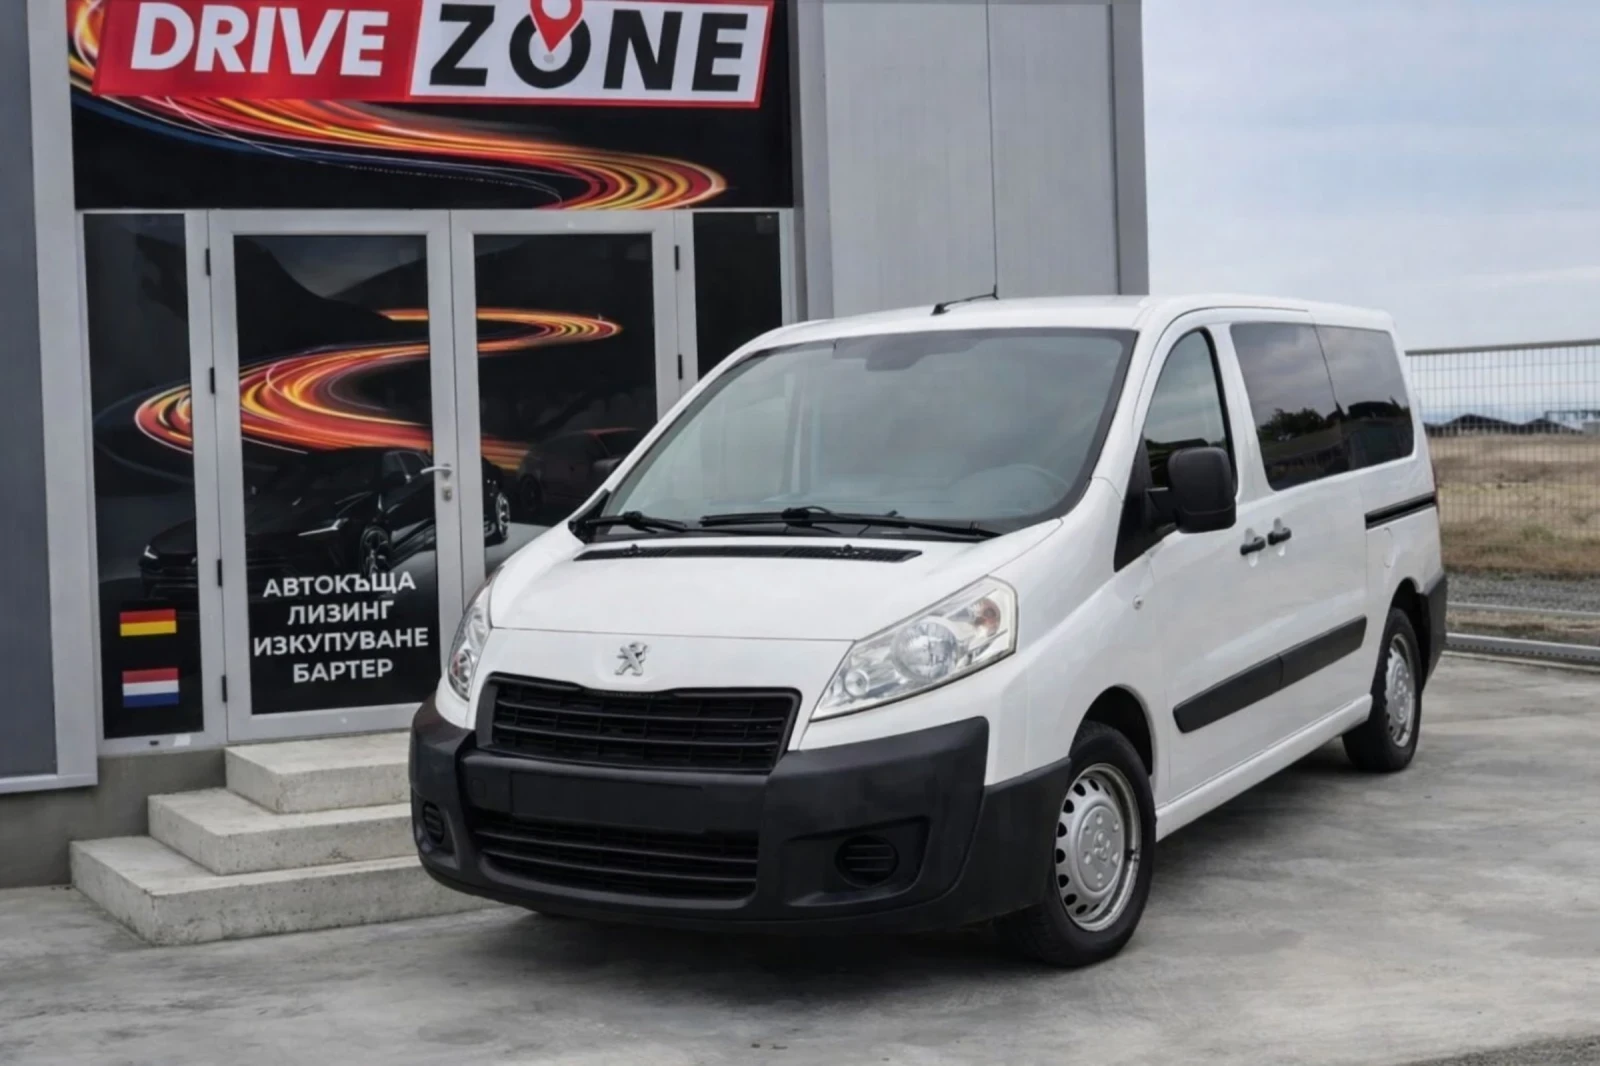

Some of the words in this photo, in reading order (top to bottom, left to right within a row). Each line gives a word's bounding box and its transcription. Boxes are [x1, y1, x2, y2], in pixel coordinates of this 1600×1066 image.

[130, 2, 389, 76] DRIVE
[429, 3, 748, 92] ZONE
[263, 571, 416, 598] АВТОКЪЩА
[287, 600, 394, 625] ЛИЗИНГ
[254, 627, 429, 656] ИЗКУПУВАНЕ
[293, 658, 393, 683] БАРТЕР
